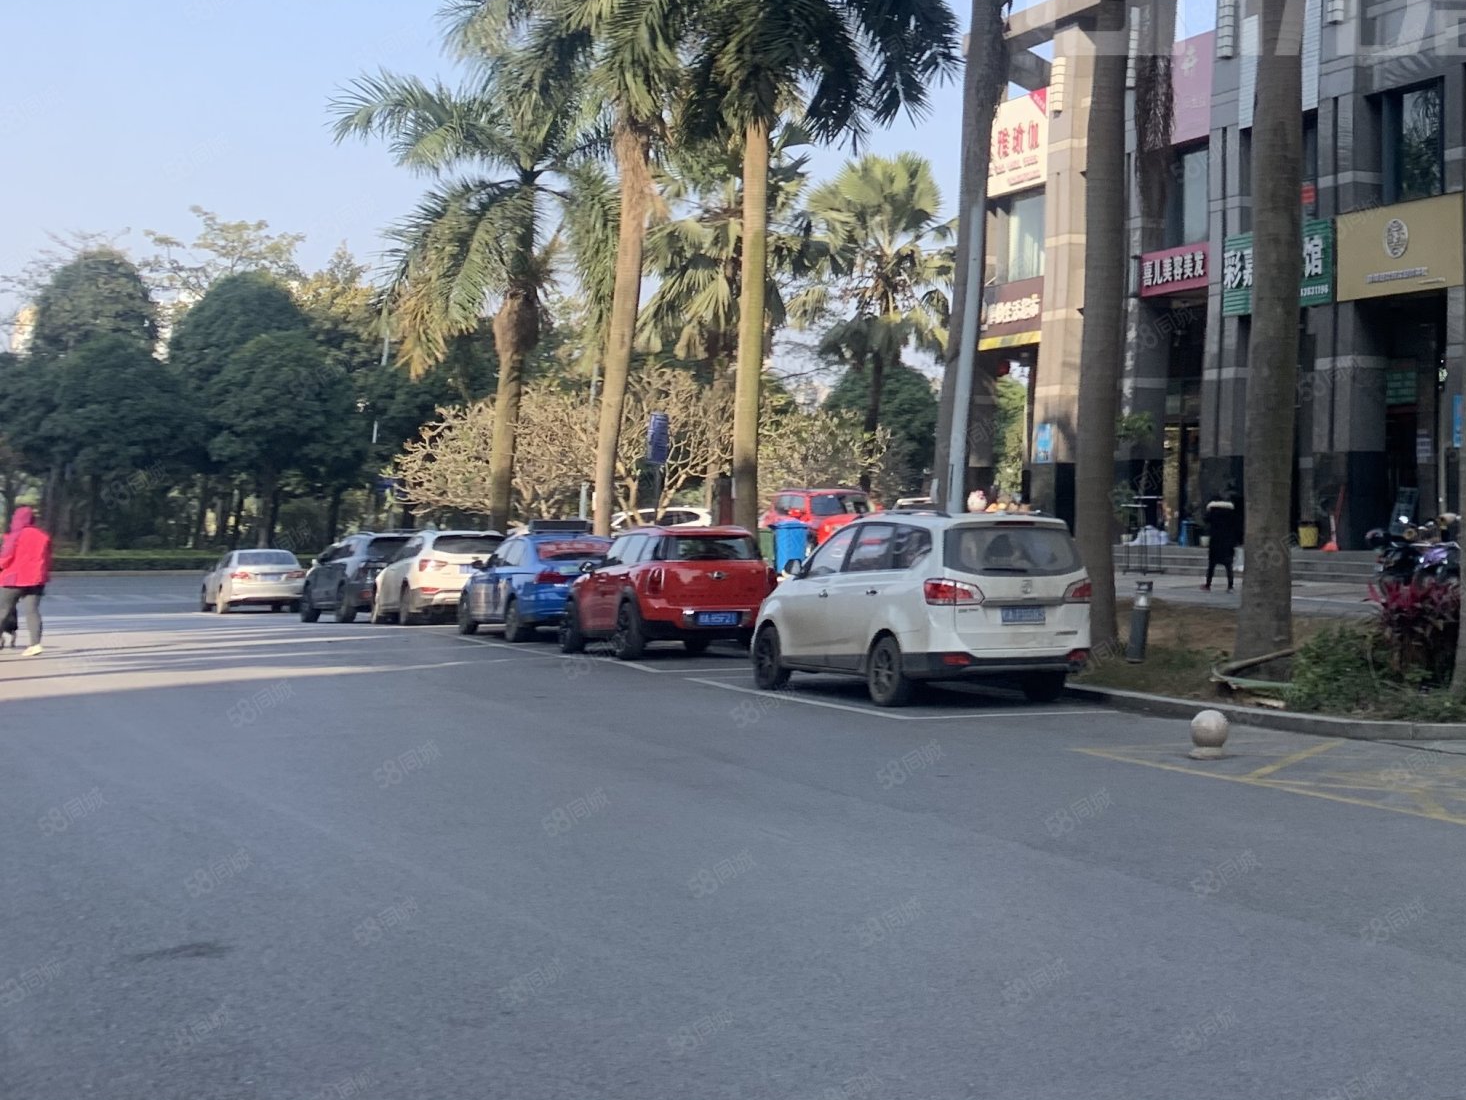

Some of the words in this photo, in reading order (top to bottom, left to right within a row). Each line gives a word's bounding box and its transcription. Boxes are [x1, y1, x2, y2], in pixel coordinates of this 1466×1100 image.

[1142, 249, 1205, 288] 喜儿美容美发
